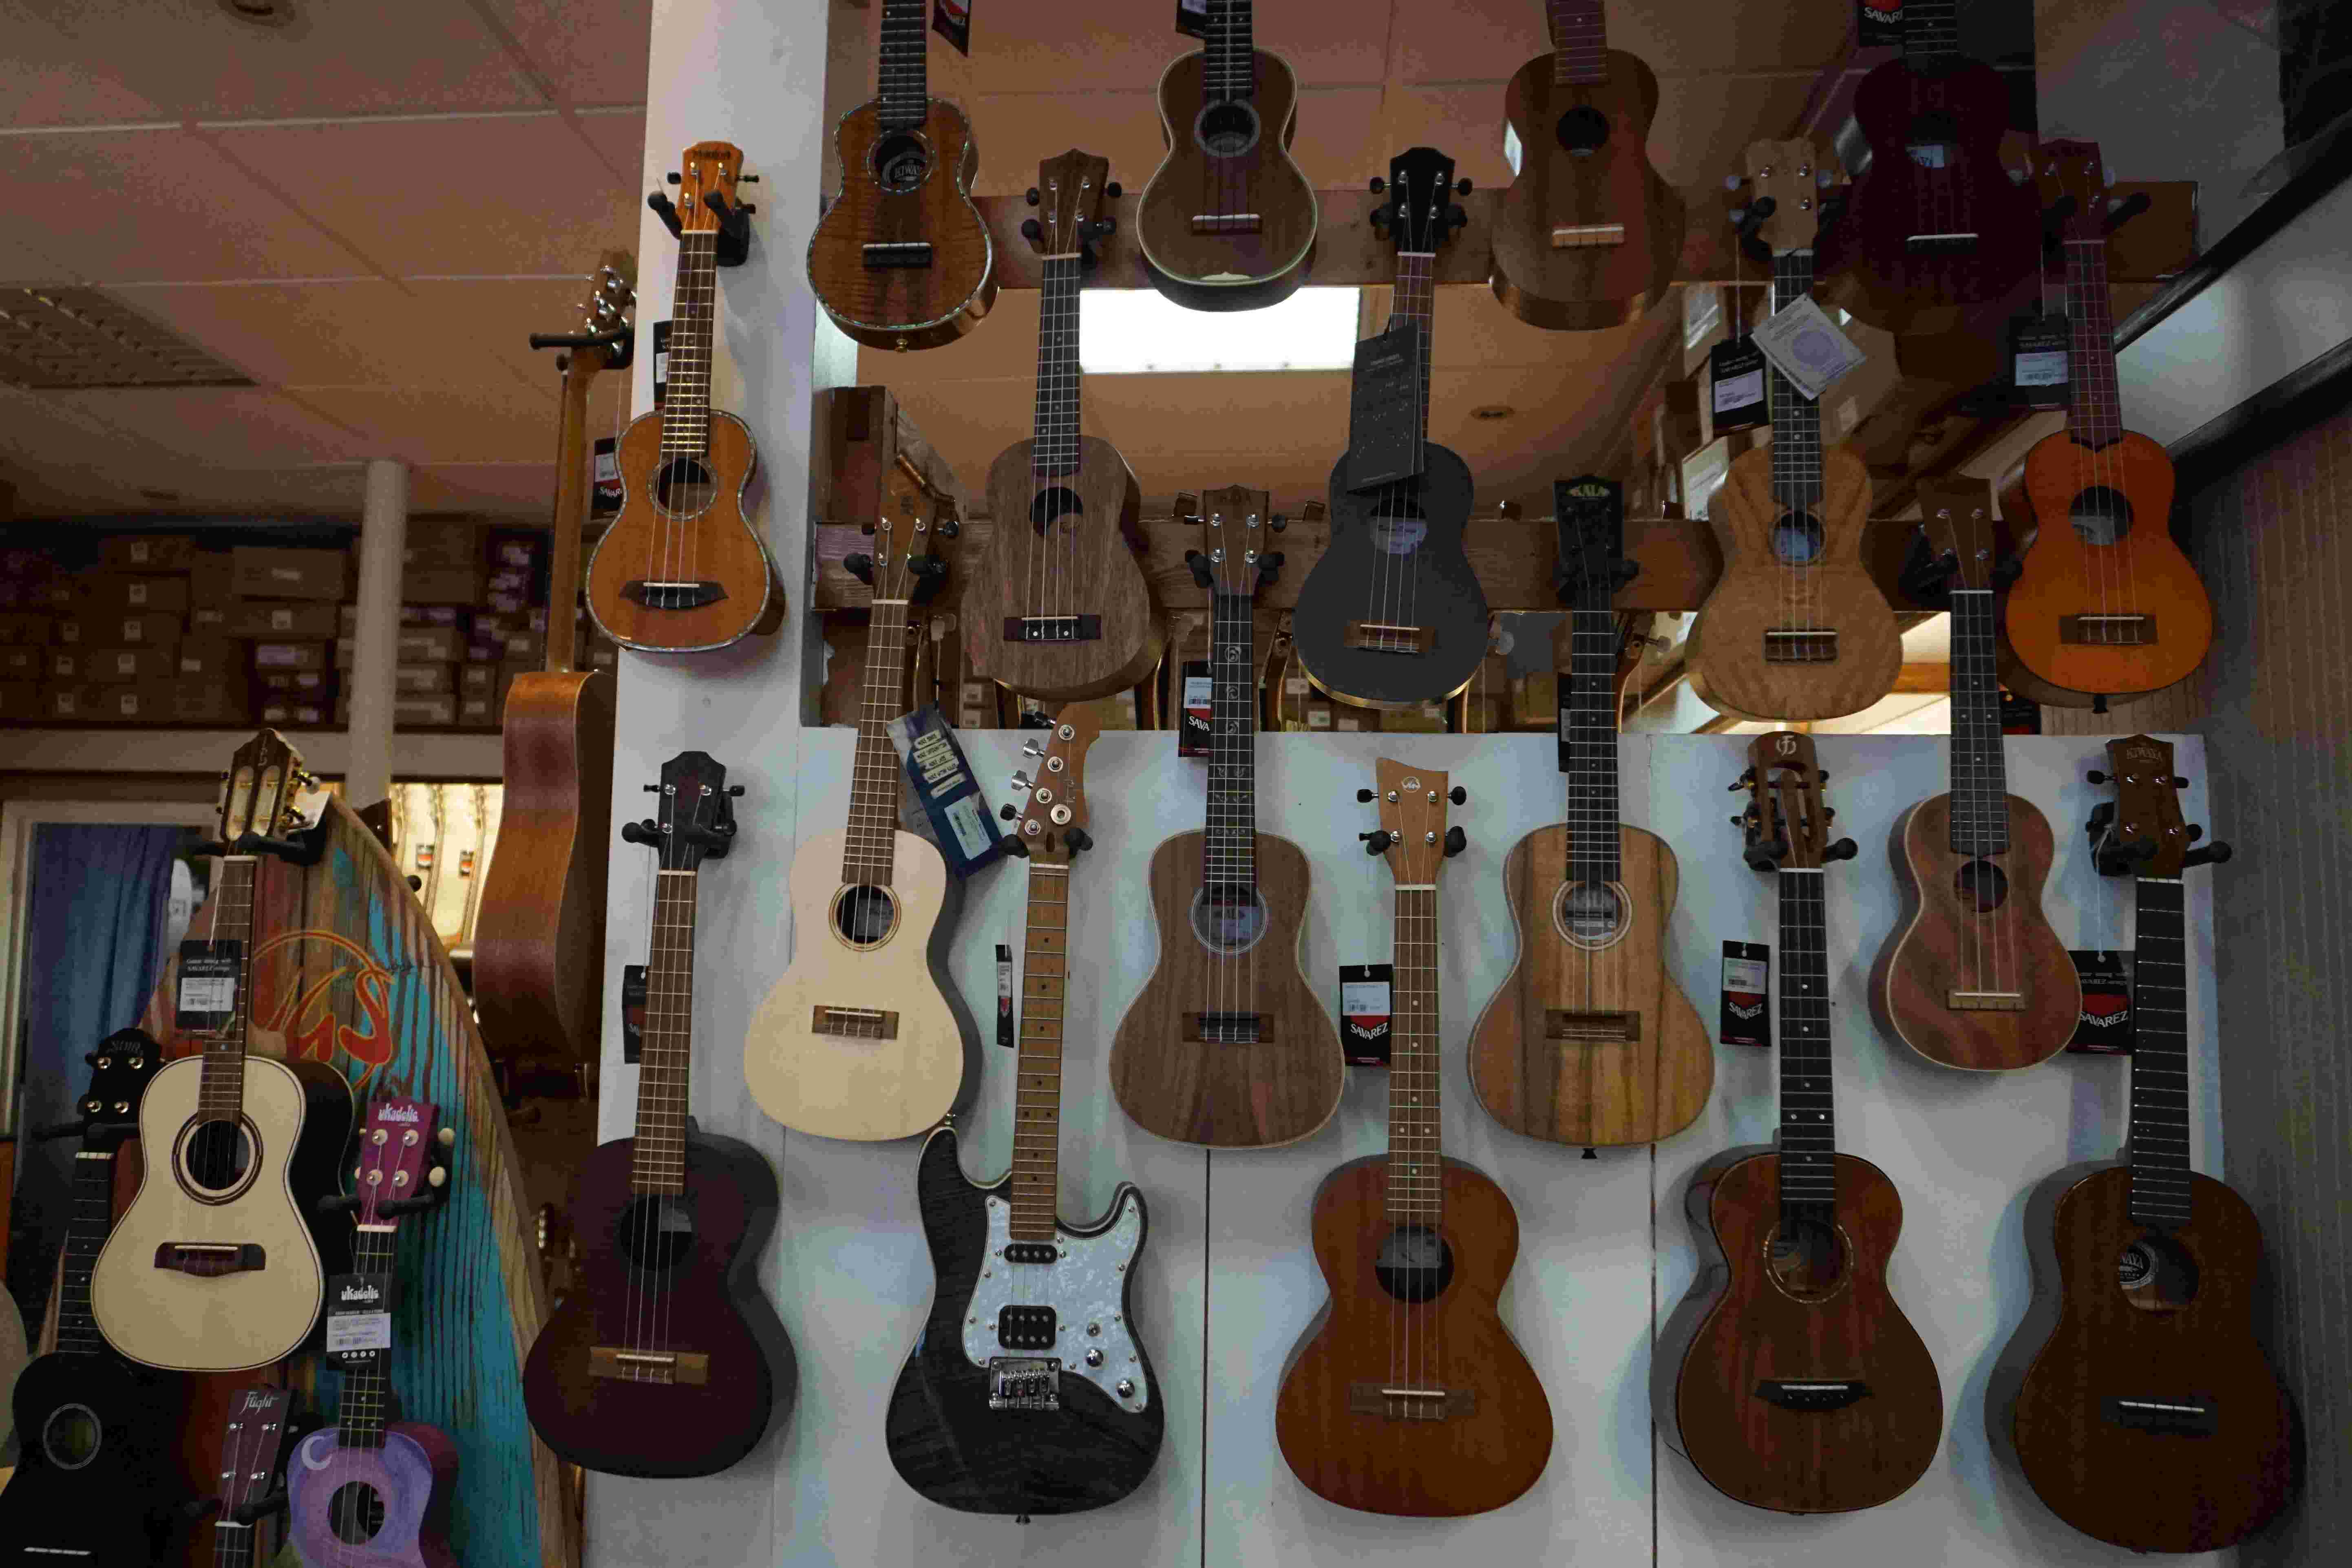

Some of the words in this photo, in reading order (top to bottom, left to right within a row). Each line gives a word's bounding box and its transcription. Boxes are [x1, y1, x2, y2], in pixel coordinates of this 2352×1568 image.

[598, 486, 620, 499] SAVAR
[1188, 716, 1210, 732] SAVA
[1728, 1001, 1764, 1020] SAVAREZ
[2080, 1010, 2129, 1028] SAVAREZ
[1350, 1023, 1388, 1040] SAVAREZ
